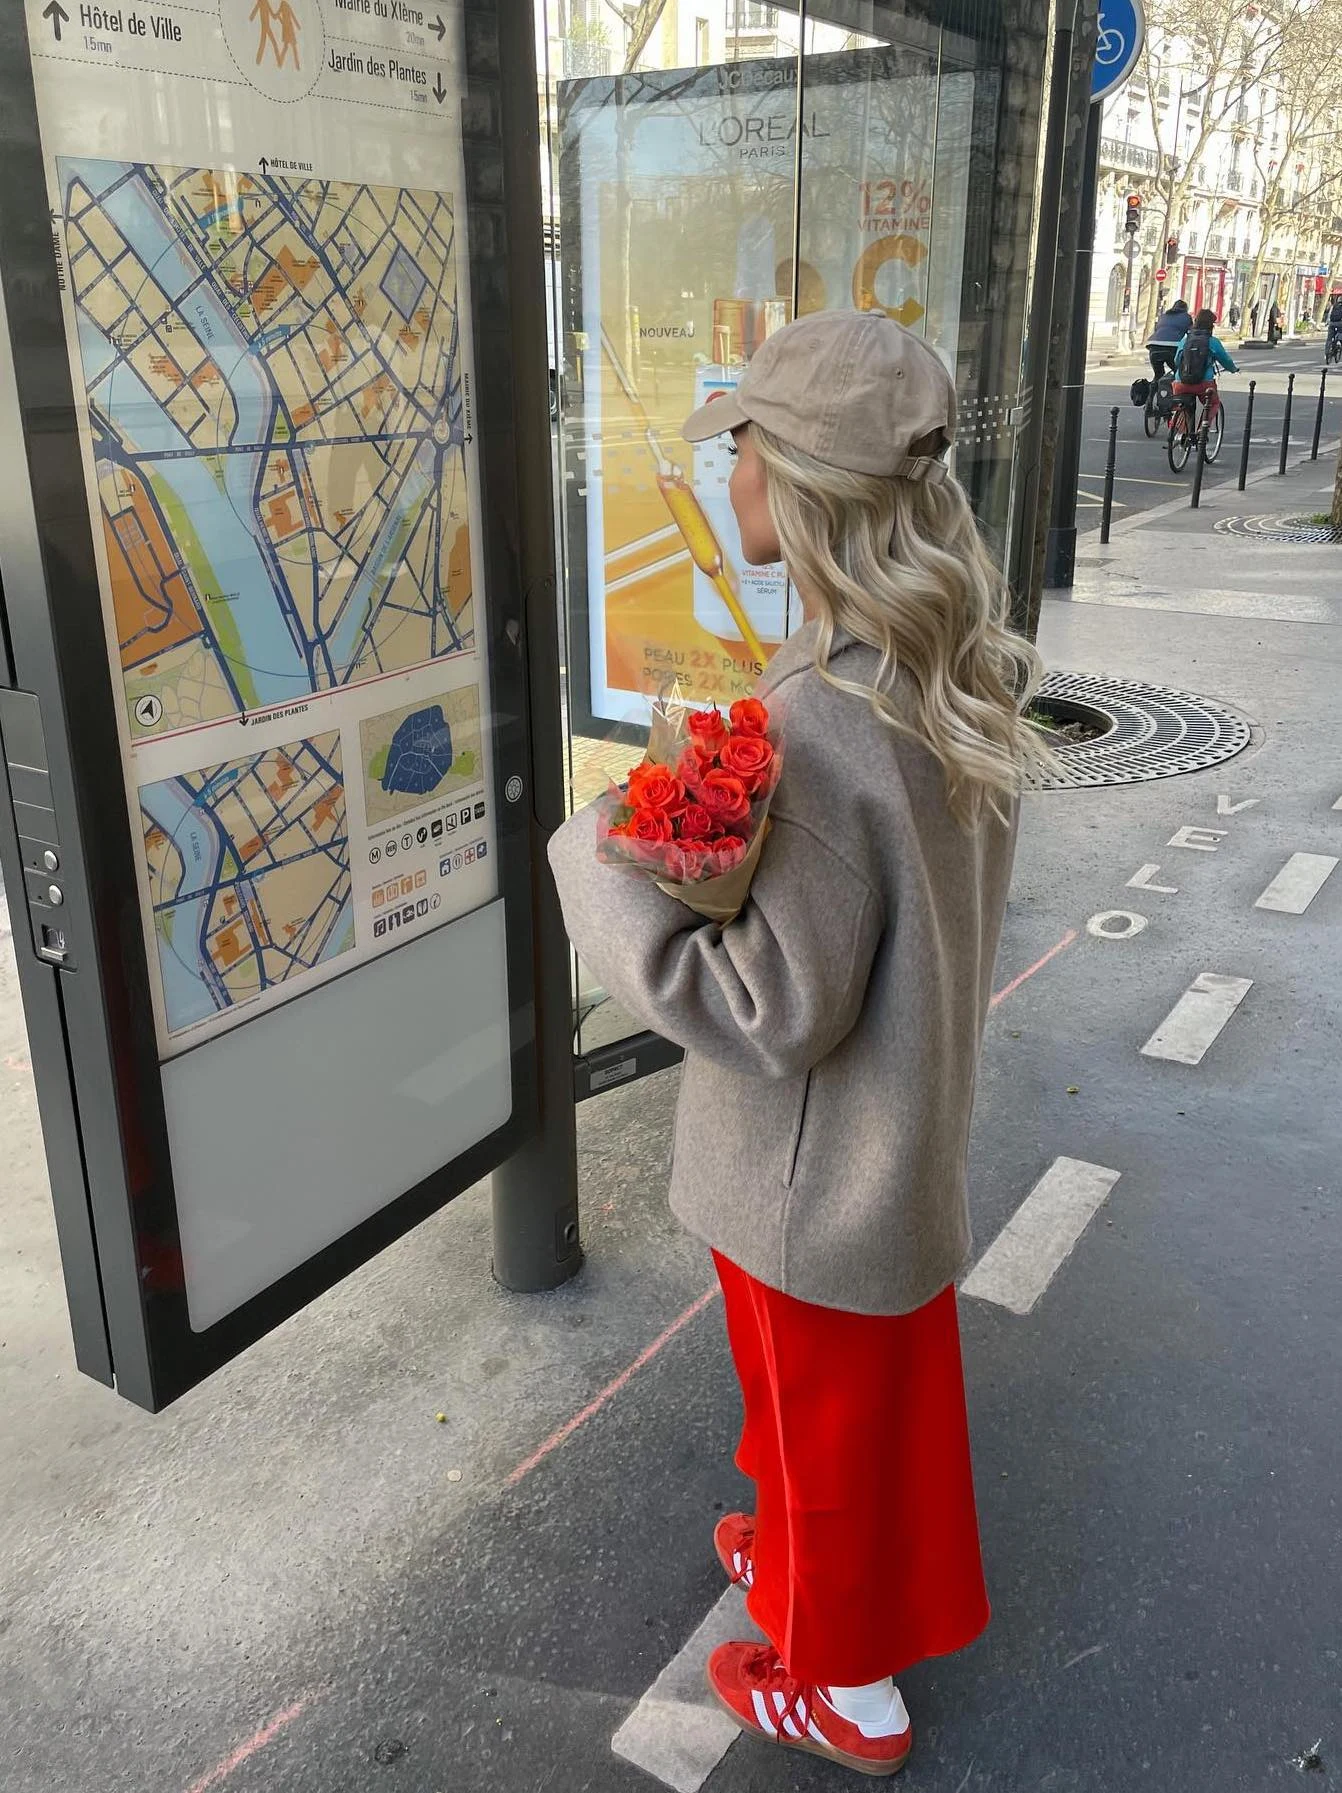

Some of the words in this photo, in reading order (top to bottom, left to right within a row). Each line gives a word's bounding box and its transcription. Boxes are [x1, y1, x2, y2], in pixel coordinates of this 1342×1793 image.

[374, 0, 388, 18] du
[80, 4, 123, 32] Hôtel
[128, 12, 146, 36] de
[150, 16, 182, 42] Ville
[84, 36, 112, 52] 15mn
[328, 49, 364, 74] Jardin
[367, 56, 386, 78] des
[389, 60, 427, 85] Plantes
[740, 146, 785, 159] PARIS
[298, 162, 313, 171] VILLE
[859, 179, 930, 217] 12%
[858, 217, 930, 232] VITAMINE
[852, 234, 929, 328] C
[640, 327, 695, 338] NOUVEAU
[644, 647, 685, 666] PEAU
[690, 650, 715, 669] 2X
[722, 658, 763, 676] PLUS
[251, 713, 272, 726] JARDIN
[272, 709, 284, 720] DES
[284, 704, 309, 716] PLANTES
